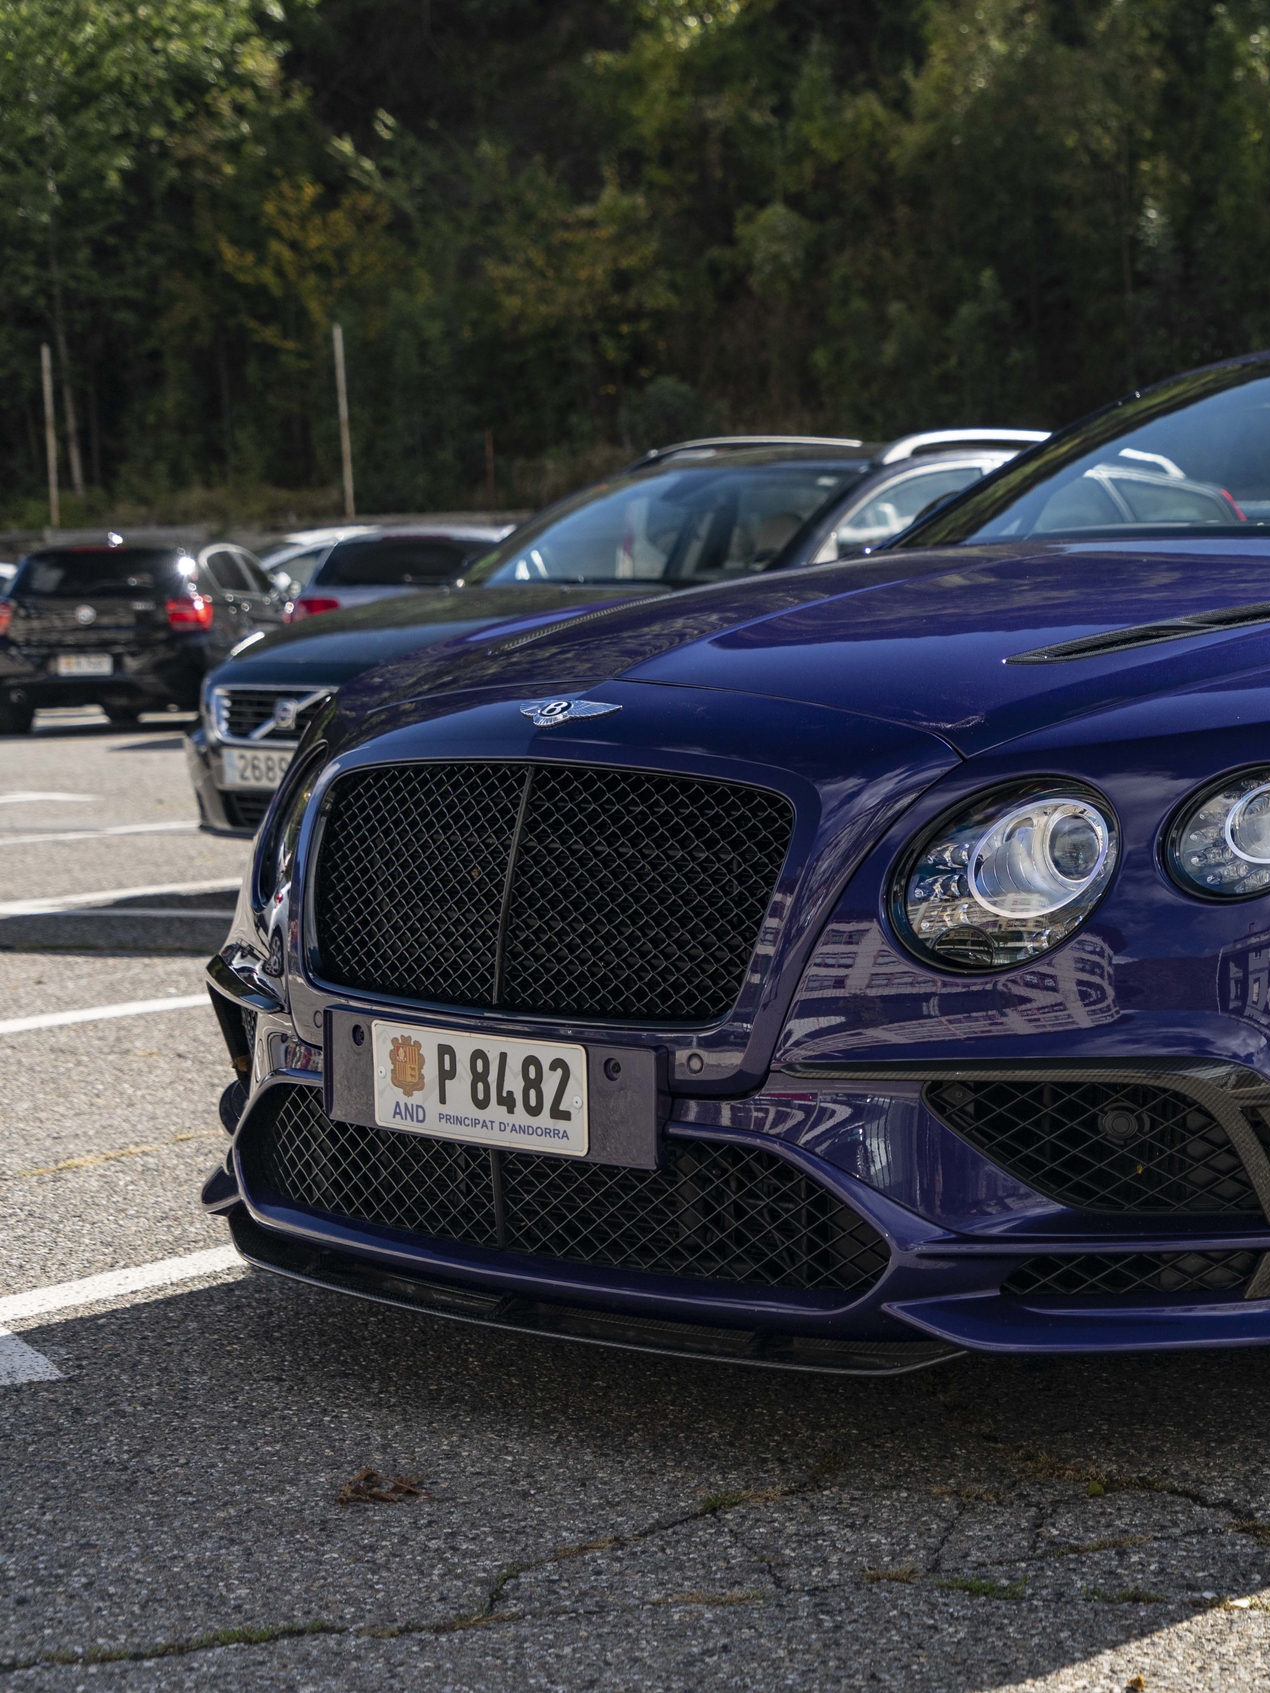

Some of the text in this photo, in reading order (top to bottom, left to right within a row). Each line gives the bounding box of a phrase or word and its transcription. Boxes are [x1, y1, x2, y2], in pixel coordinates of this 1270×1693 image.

[437, 1043, 572, 1121] P 8482
[392, 1100, 570, 1141] AND PRINCIPAT D'ANDORRA
